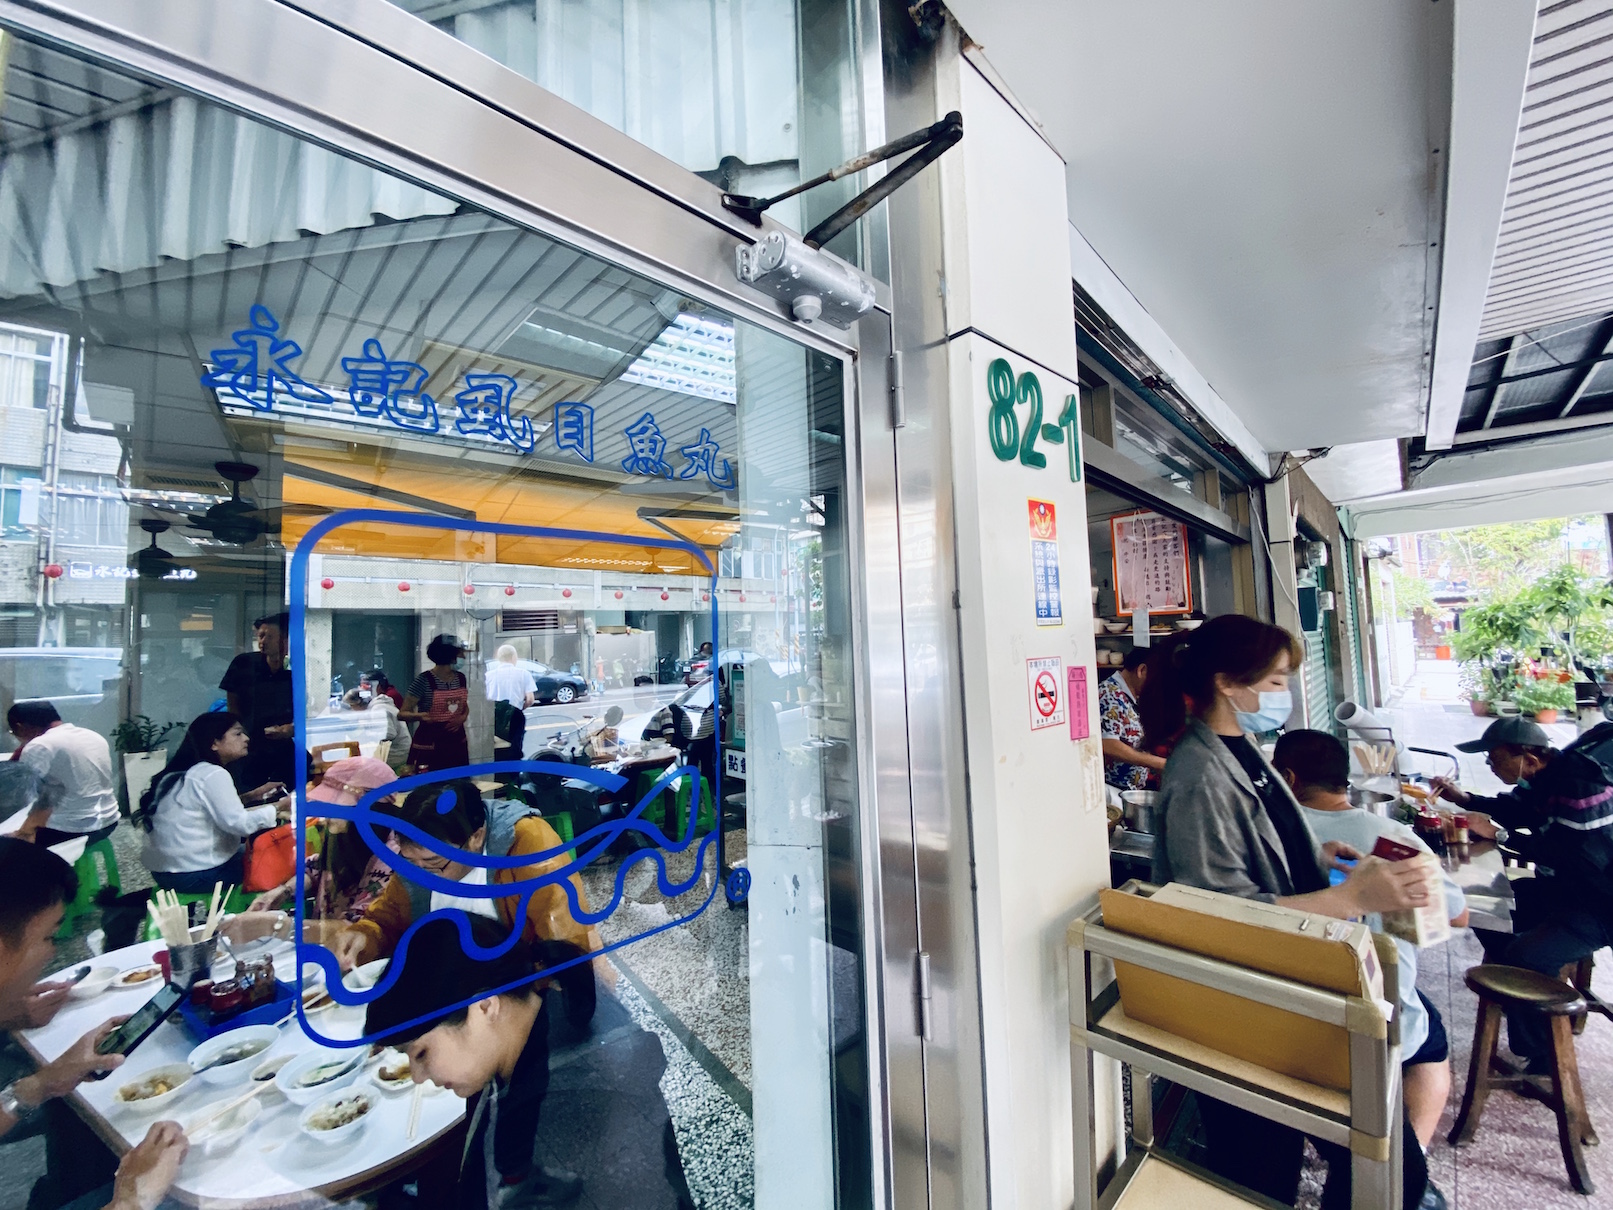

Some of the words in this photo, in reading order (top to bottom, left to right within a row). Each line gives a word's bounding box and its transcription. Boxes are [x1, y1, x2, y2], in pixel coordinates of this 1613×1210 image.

[202, 304, 737, 490] 永記虱目魚丸
[987, 357, 1081, 483] 82-1
